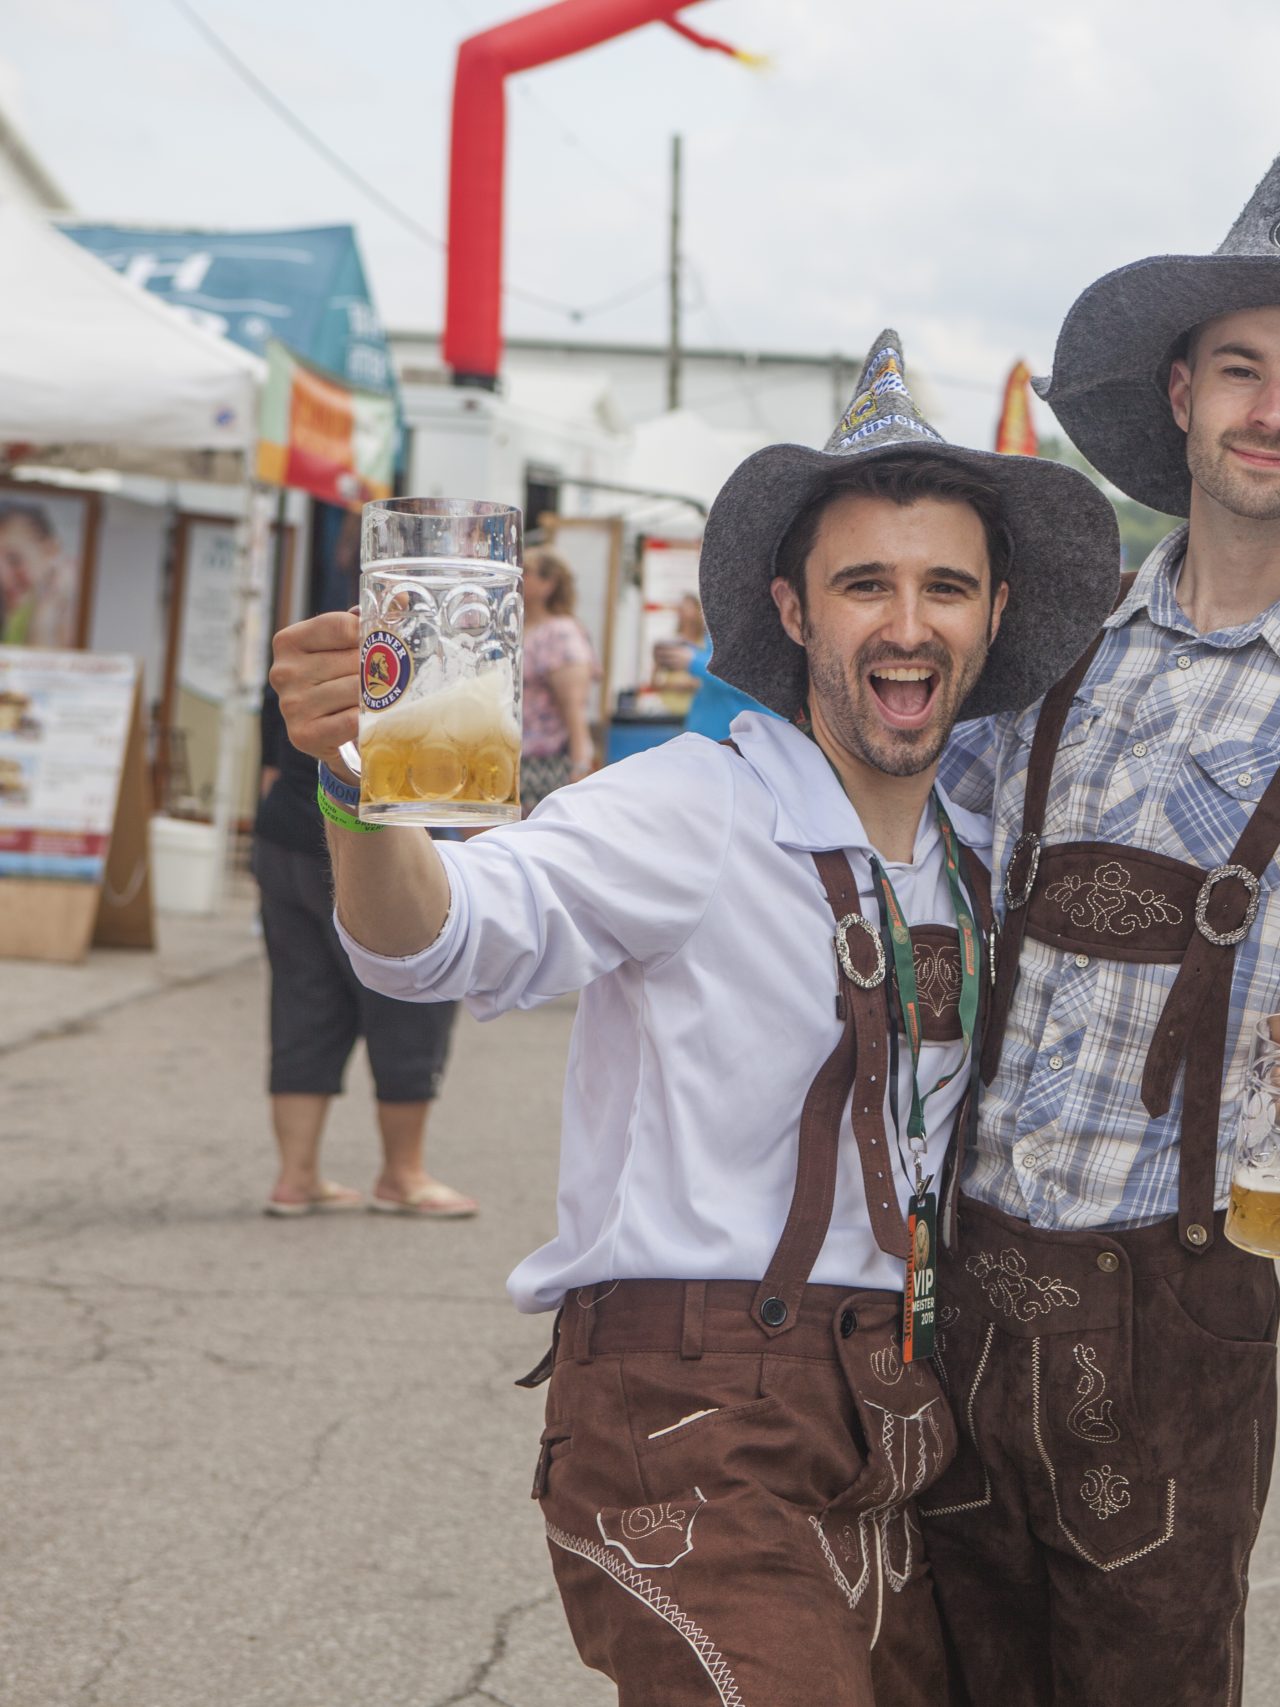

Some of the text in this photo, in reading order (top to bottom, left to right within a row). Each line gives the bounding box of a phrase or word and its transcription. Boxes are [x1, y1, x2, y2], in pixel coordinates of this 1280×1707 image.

[914, 1268, 934, 1298] VIP
[912, 1297, 935, 1312] MEISTER
[921, 1311, 934, 1326] 2019
